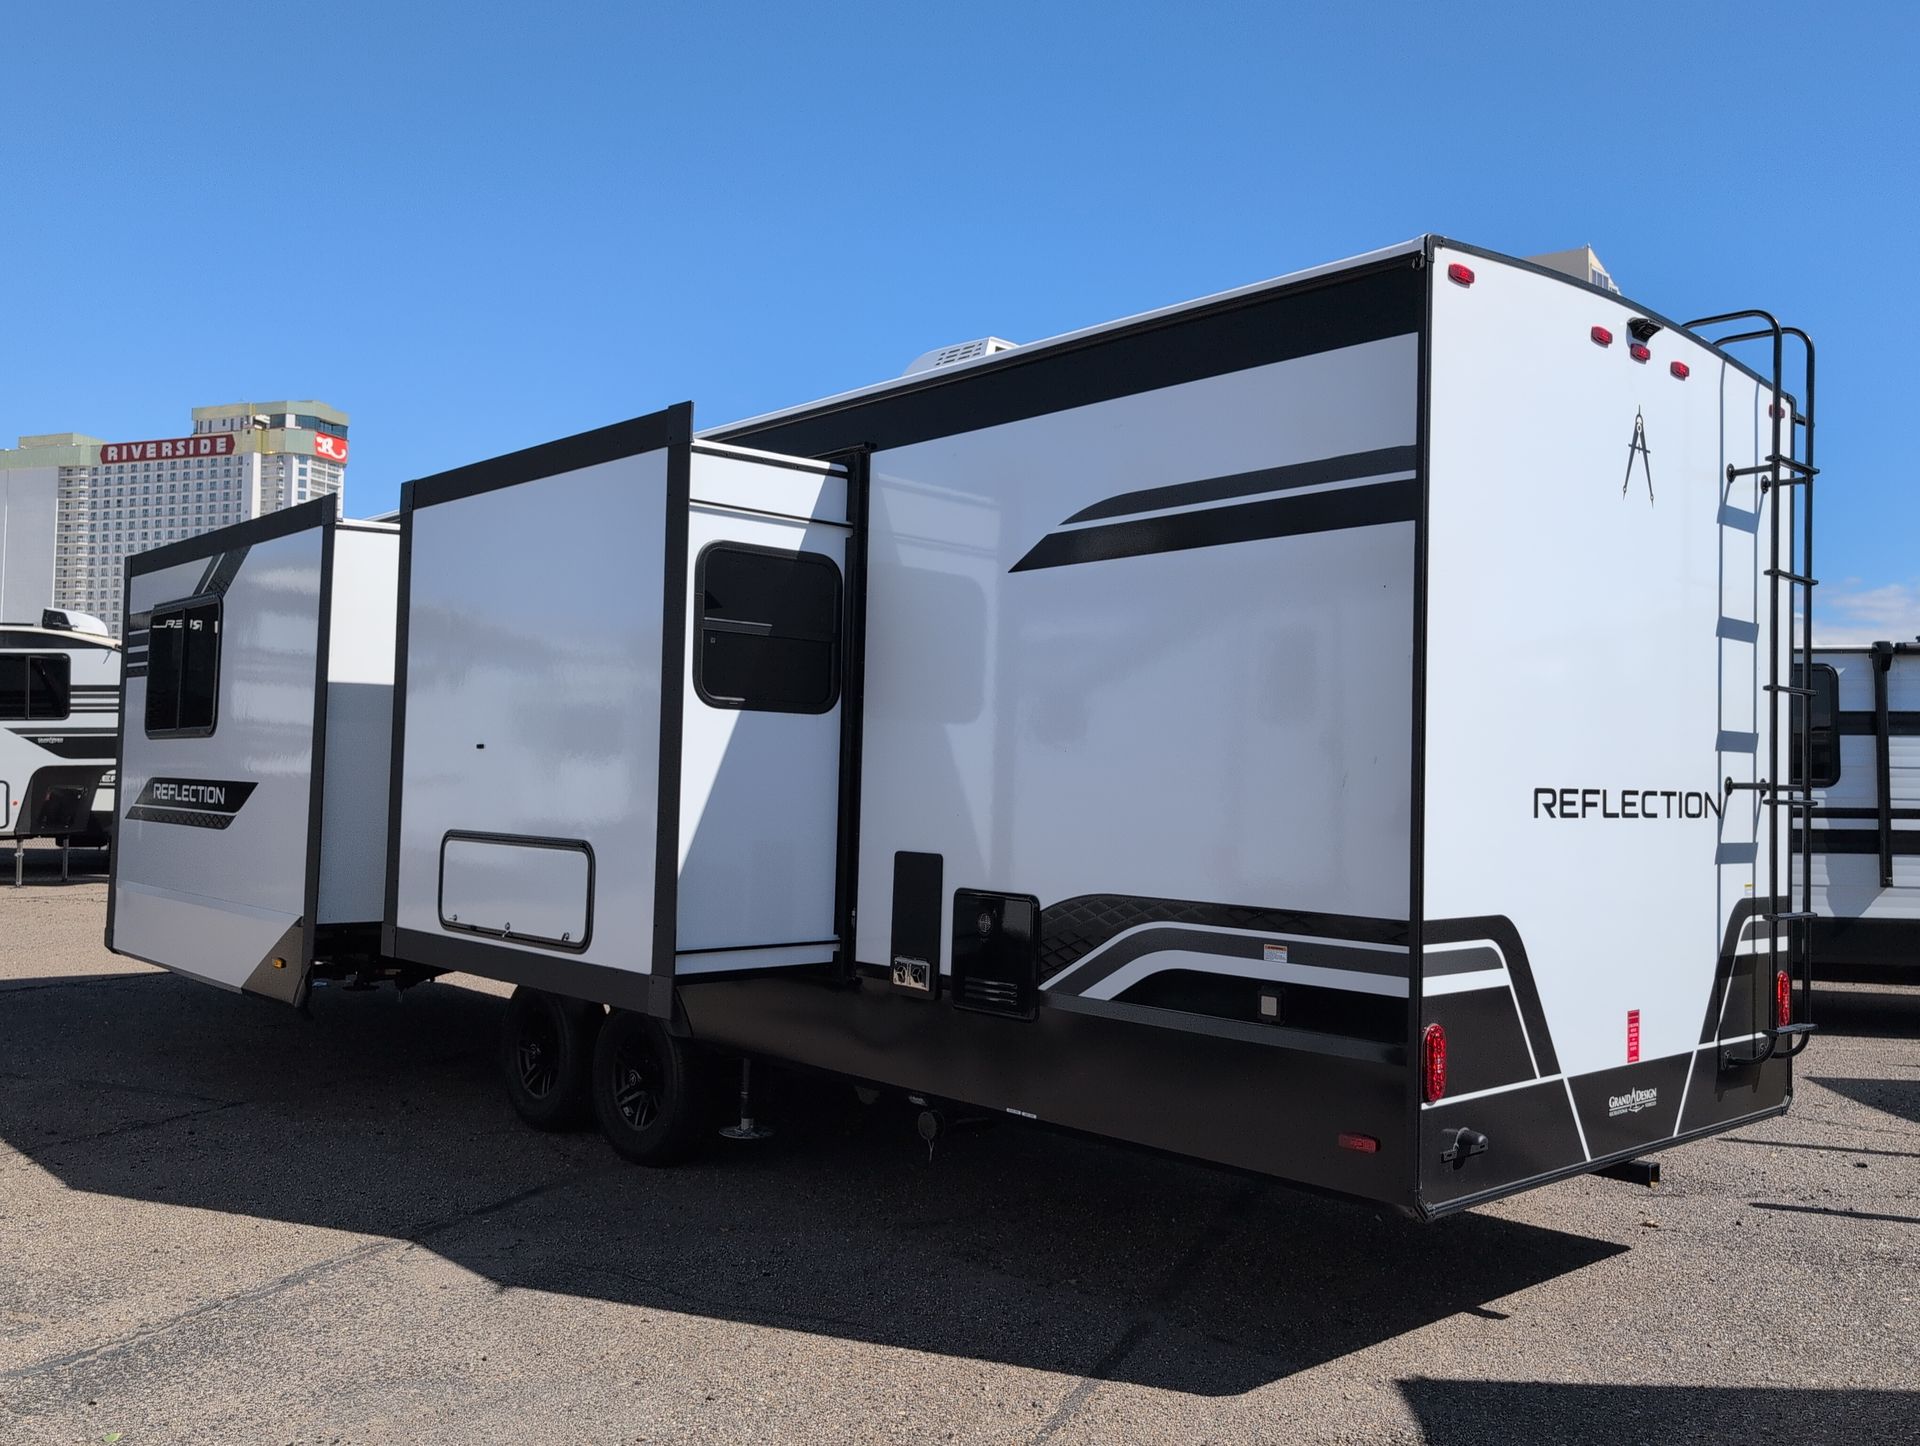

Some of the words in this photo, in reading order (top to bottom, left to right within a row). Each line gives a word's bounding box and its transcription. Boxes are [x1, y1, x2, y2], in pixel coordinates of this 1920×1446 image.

[107, 437, 227, 461] RIVERSIDE
[153, 782, 225, 805] REFLECTION
[1533, 787, 1722, 819] REFLECTION
[1609, 1094, 1631, 1109] GRAND
[1636, 1087, 1657, 1102] DESIGN
